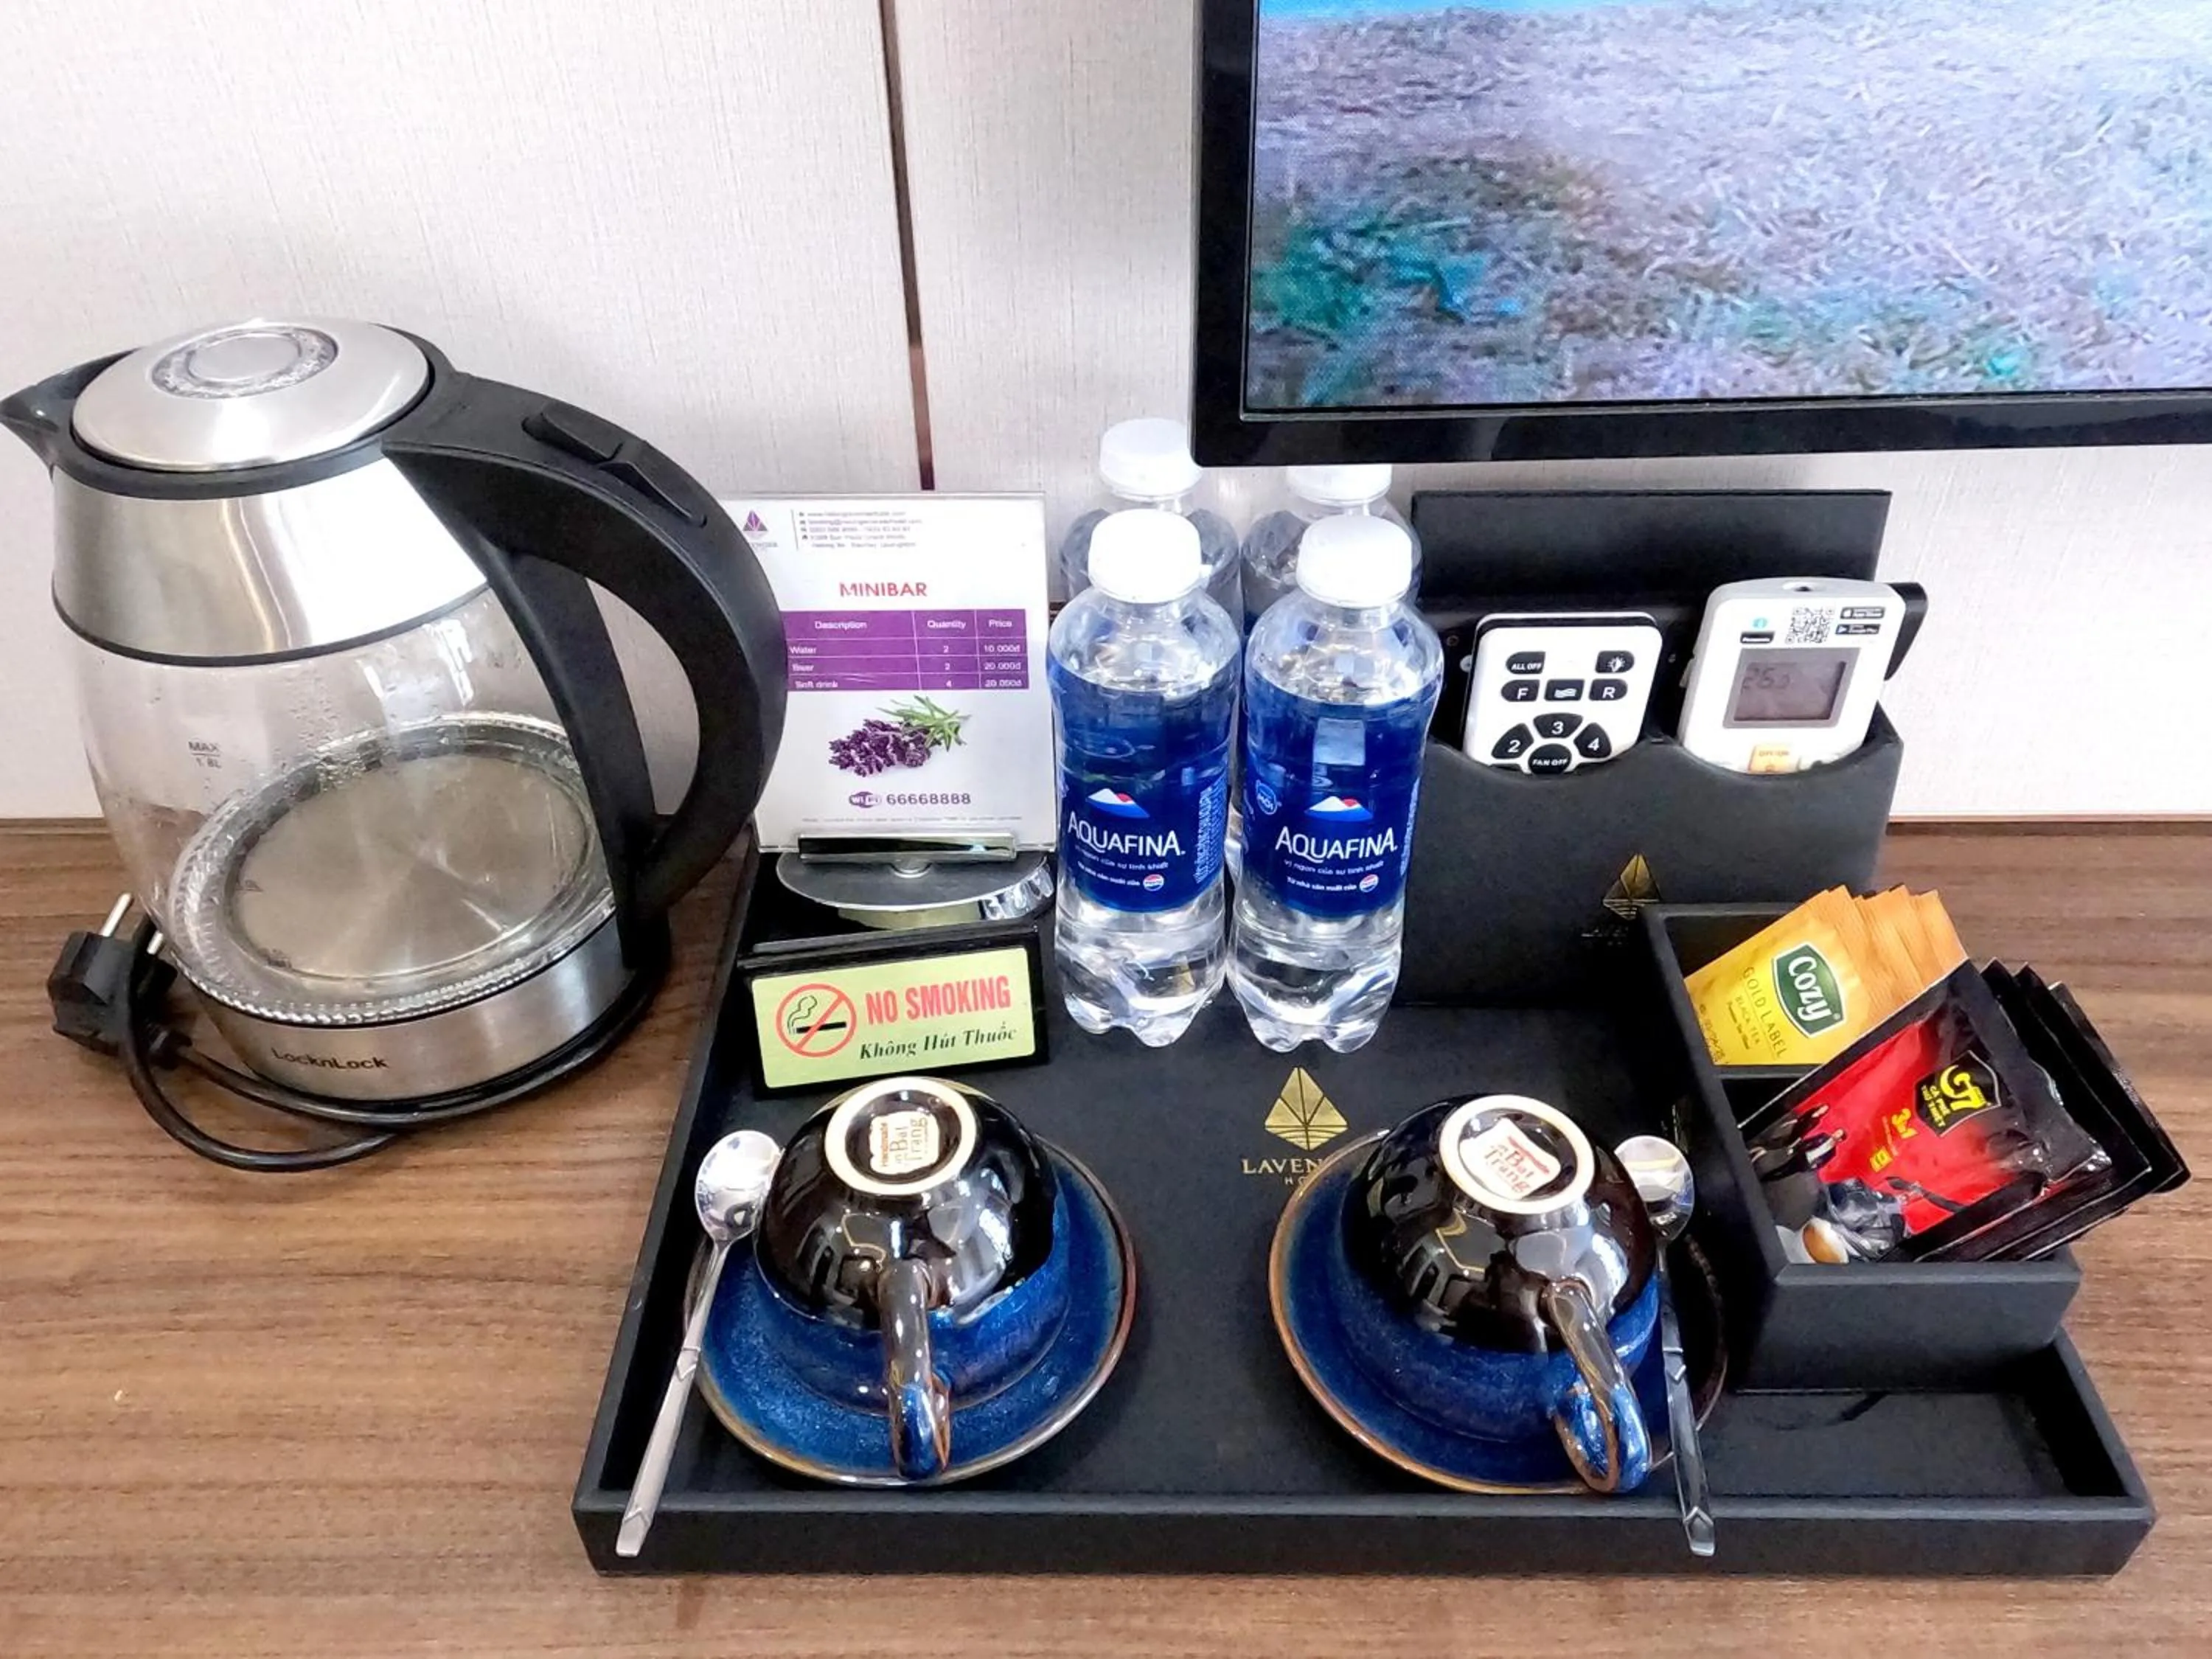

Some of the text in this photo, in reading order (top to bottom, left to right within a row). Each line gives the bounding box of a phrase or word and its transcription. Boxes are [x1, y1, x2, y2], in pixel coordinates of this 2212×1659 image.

[840, 582, 928, 598] MINIBAR
[815, 620, 868, 631] Description
[926, 619, 967, 630] Quantity
[988, 619, 1013, 628] Price
[790, 646, 816, 655] Water
[943, 644, 950, 653] 2
[795, 679, 838, 689] Soft drink
[1517, 686, 1529, 700] F
[1601, 686, 1616, 699] R
[1550, 721, 1565, 735] 3
[1507, 739, 1521, 754] 2
[1587, 737, 1600, 752] 4
[1531, 758, 1568, 766] FAN OFF
[886, 793, 972, 805] 66668888
[1067, 810, 1183, 858] AQUAFINA
[1275, 826, 1398, 863] AQUAFINA
[1788, 956, 1832, 1021] Cozy
[864, 975, 1012, 1026] NO SMOKING
[1735, 995, 1761, 1044] BLACK TEA
[1742, 966, 1787, 1059] GOLD LABEL
[860, 1021, 1018, 1060] Không Hút Thuốc
[271, 1047, 389, 1069] LocknLock
[1940, 1064, 1987, 1112] G7
[1241, 1158, 1323, 1175] LAVEN
